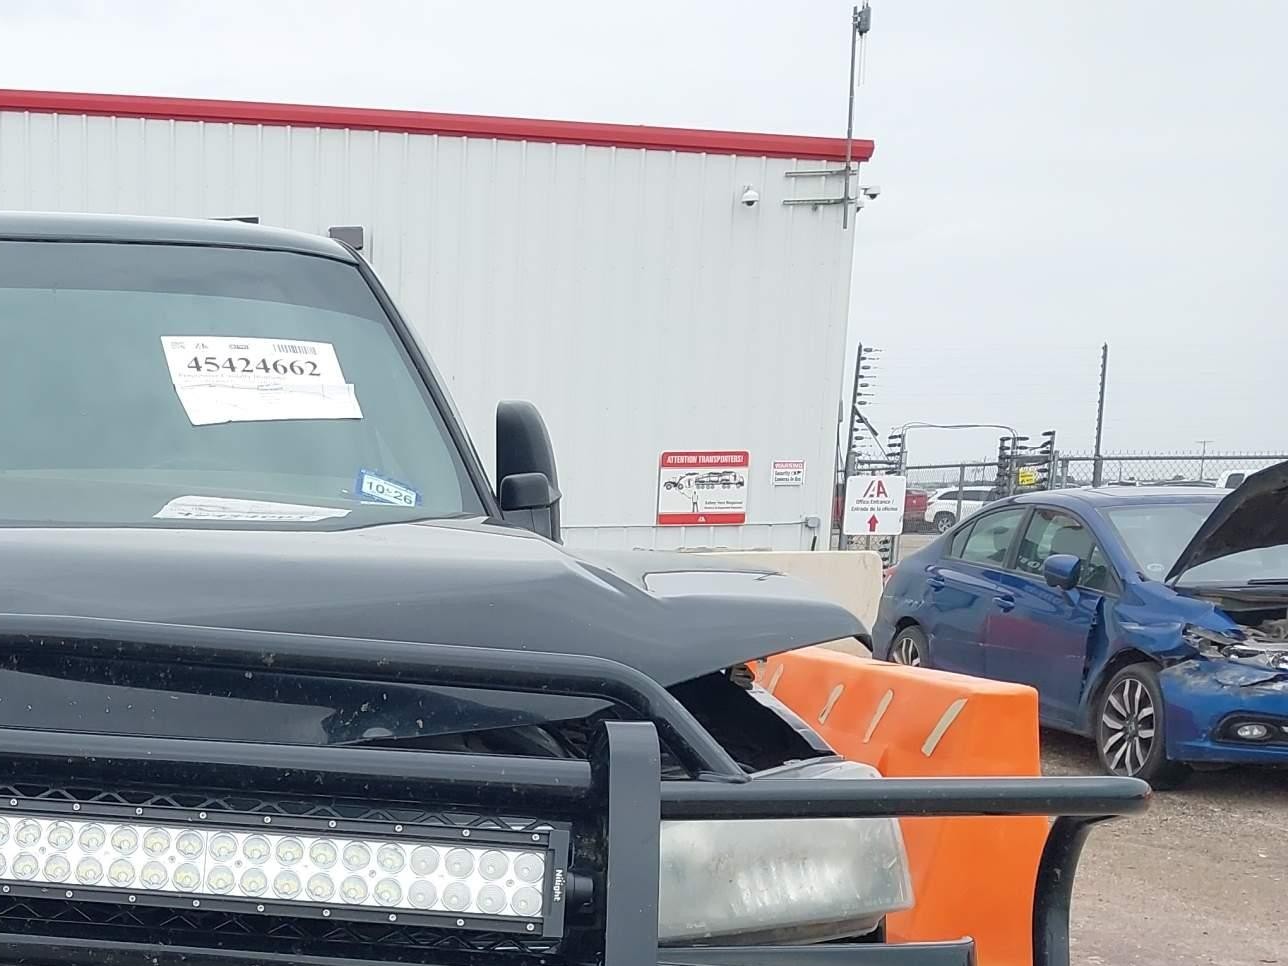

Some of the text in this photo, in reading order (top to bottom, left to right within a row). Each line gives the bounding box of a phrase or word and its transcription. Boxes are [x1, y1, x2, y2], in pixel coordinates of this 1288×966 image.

[187, 356, 321, 376] 45424662
[666, 454, 744, 464] ATTENTION TRANSPORTERS!
[553, 869, 566, 902] Nilight
